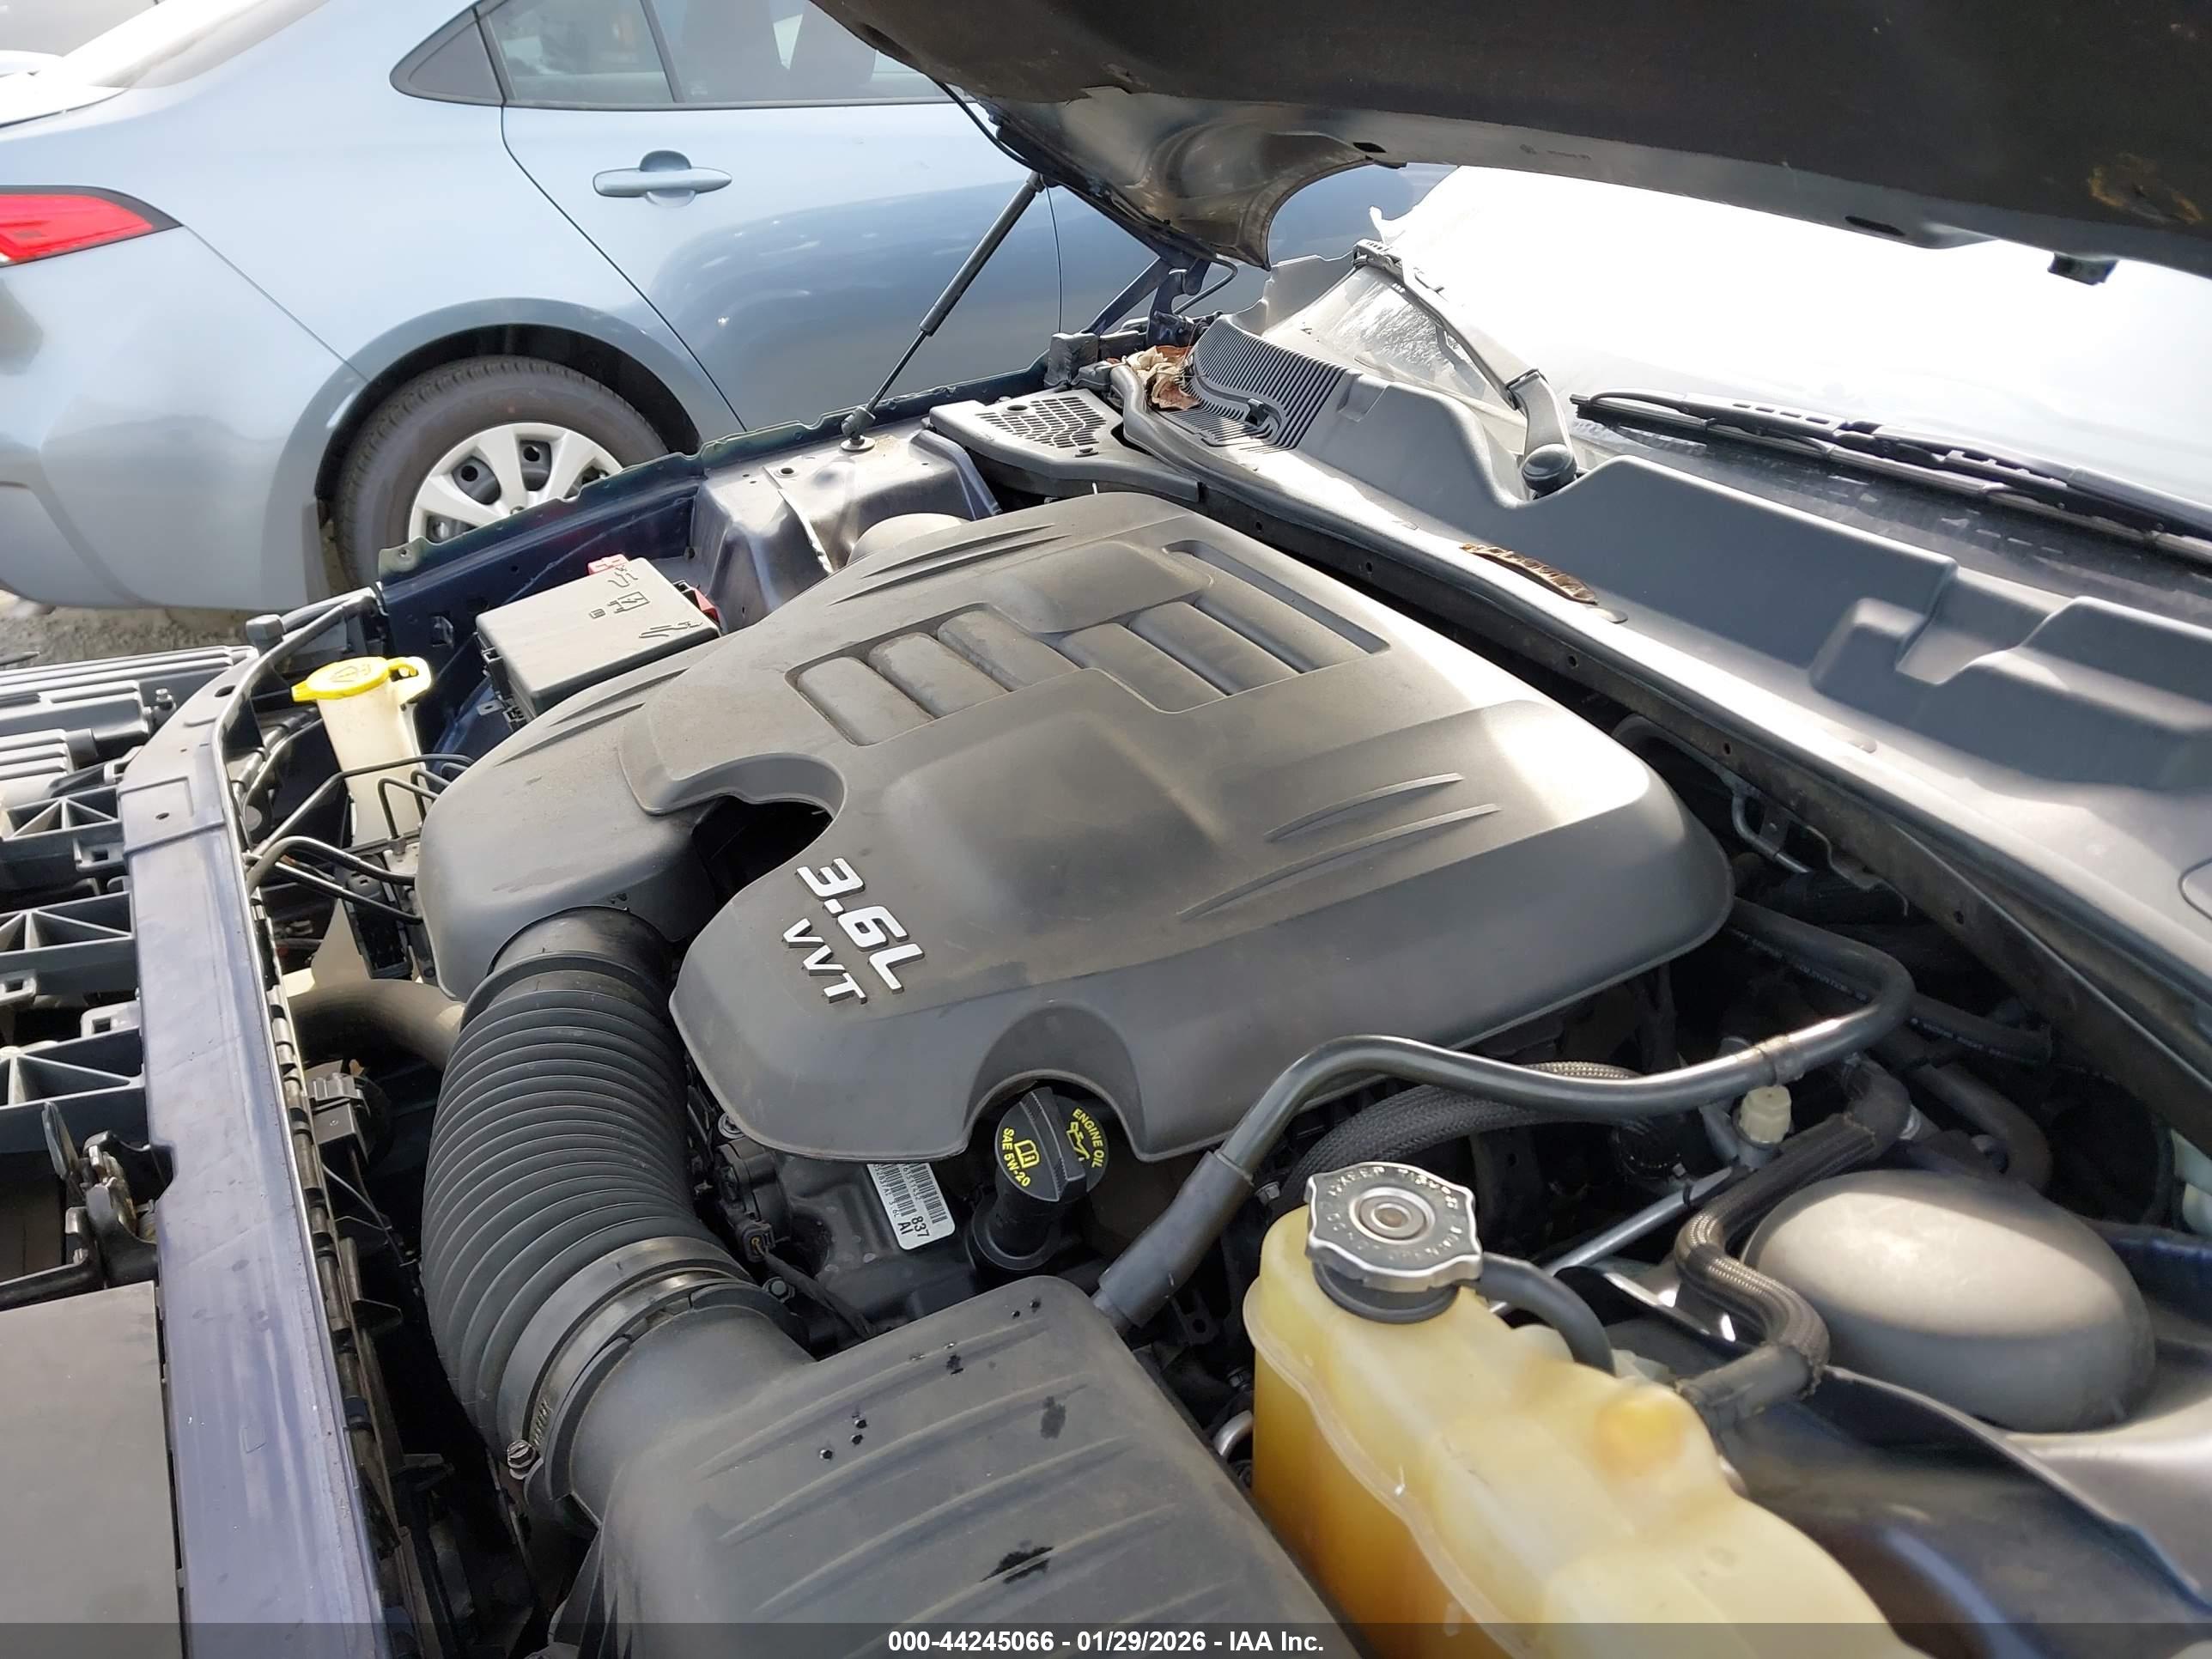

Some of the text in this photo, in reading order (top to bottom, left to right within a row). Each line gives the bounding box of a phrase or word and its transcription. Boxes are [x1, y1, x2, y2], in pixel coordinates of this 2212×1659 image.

[796, 857, 925, 991] 3.6L
[782, 917, 867, 1000] VVT
[1001, 1127, 1031, 1187] SAE 5W-20
[1073, 1108, 1105, 1168] ENGINE OIL
[897, 1221, 915, 1235] AI
[911, 1215, 930, 1237] 837
